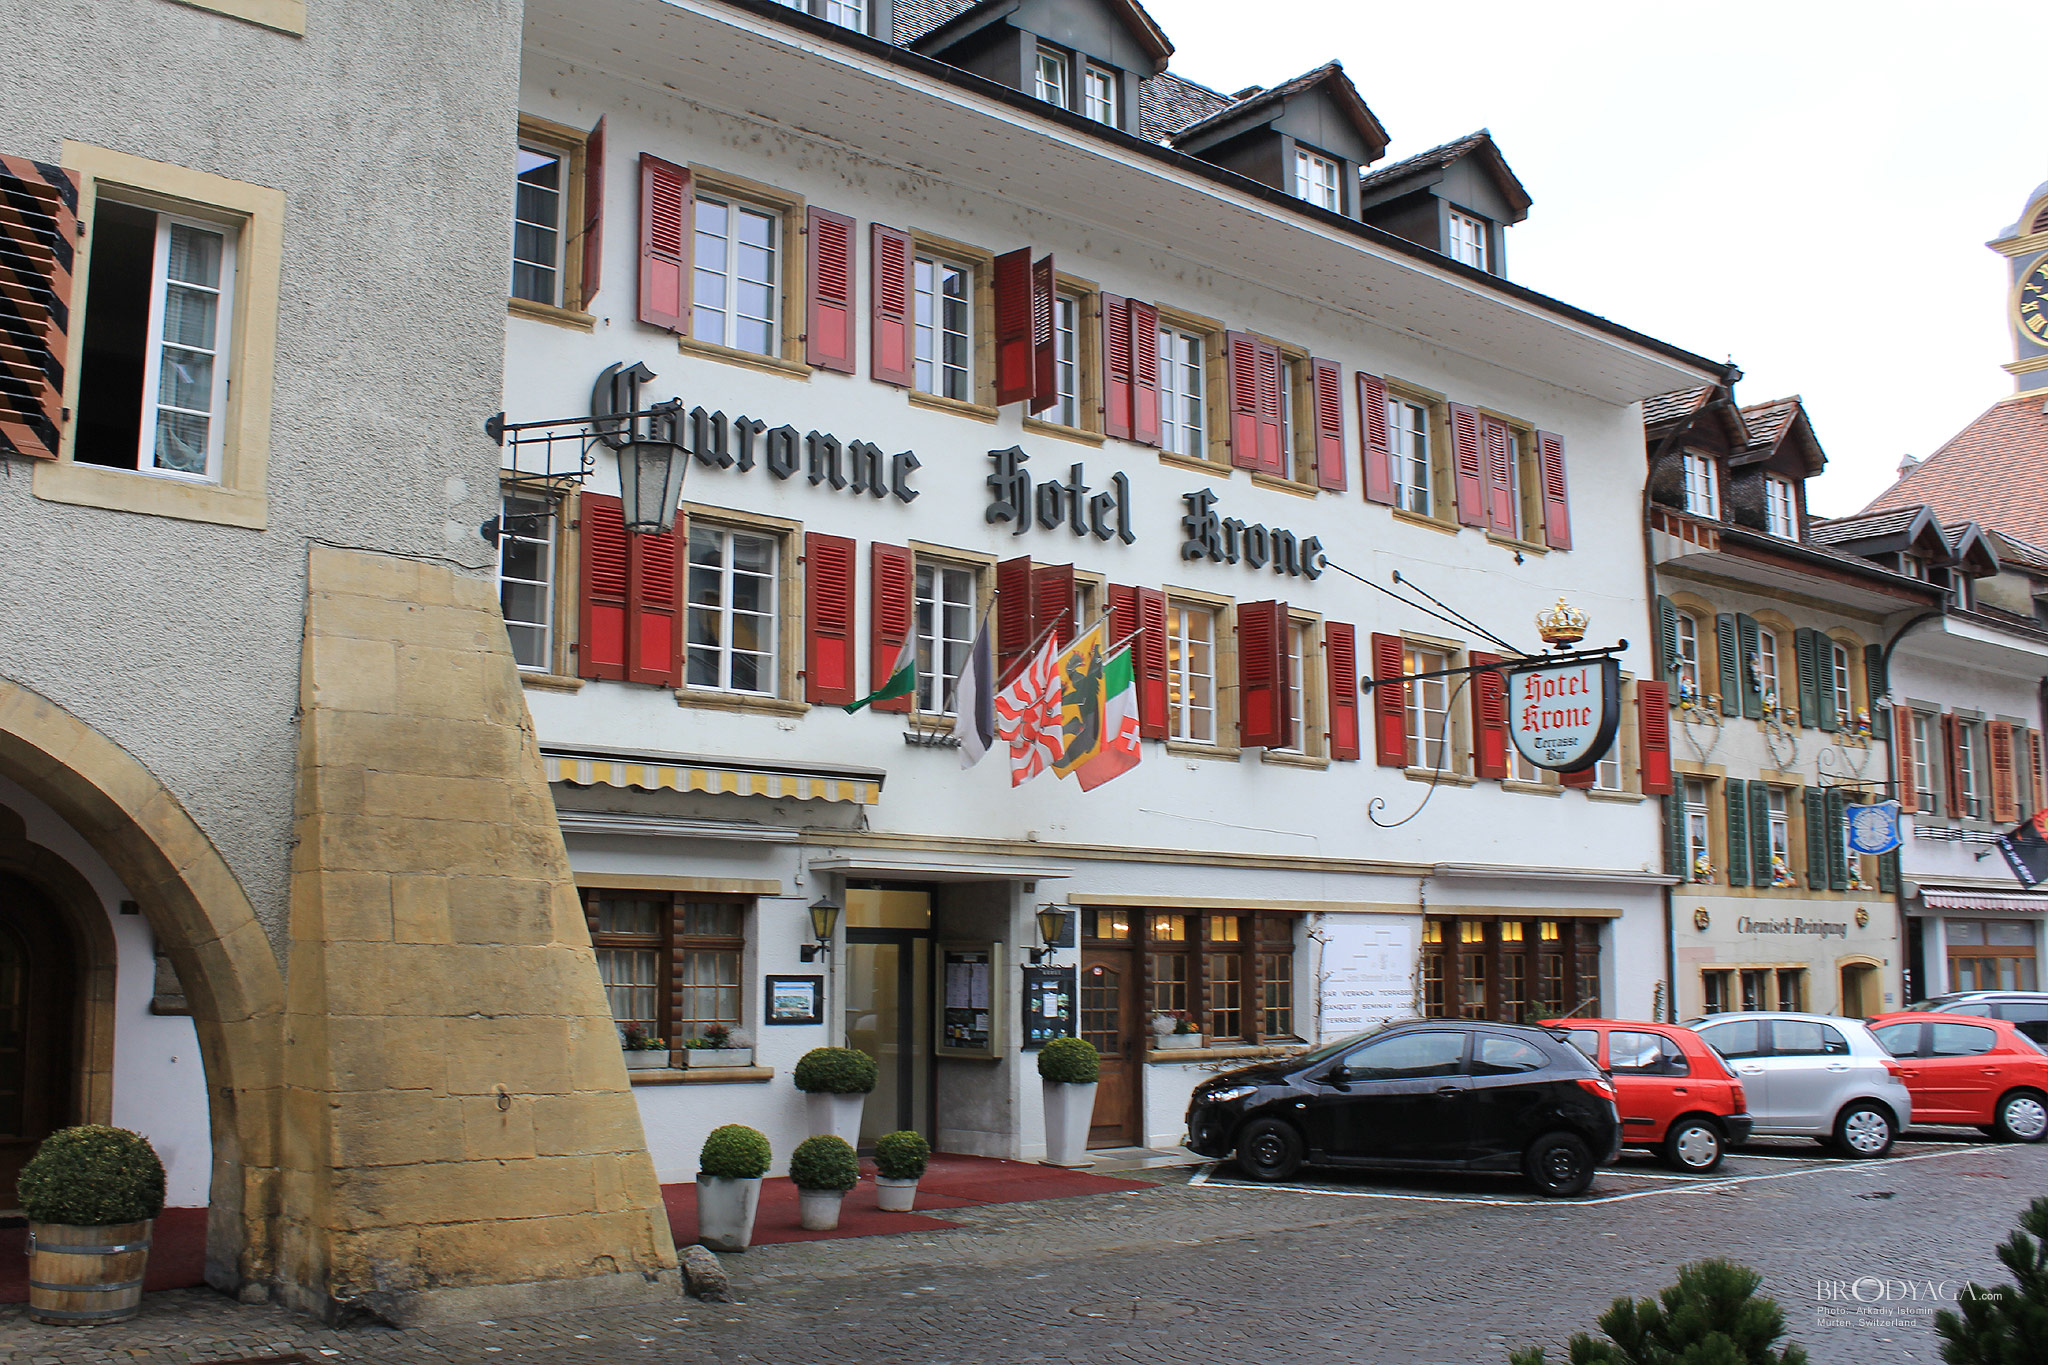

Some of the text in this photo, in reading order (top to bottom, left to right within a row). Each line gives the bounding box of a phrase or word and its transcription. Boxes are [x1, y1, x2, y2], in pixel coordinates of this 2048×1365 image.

[986, 445, 1137, 546] Hotel
[1181, 487, 1324, 580] Krone
[1523, 668, 1590, 704] Hotel
[1521, 704, 1592, 733] Krone
[1534, 736, 1579, 749] Terrasse
[1545, 749, 1568, 761] Bar
